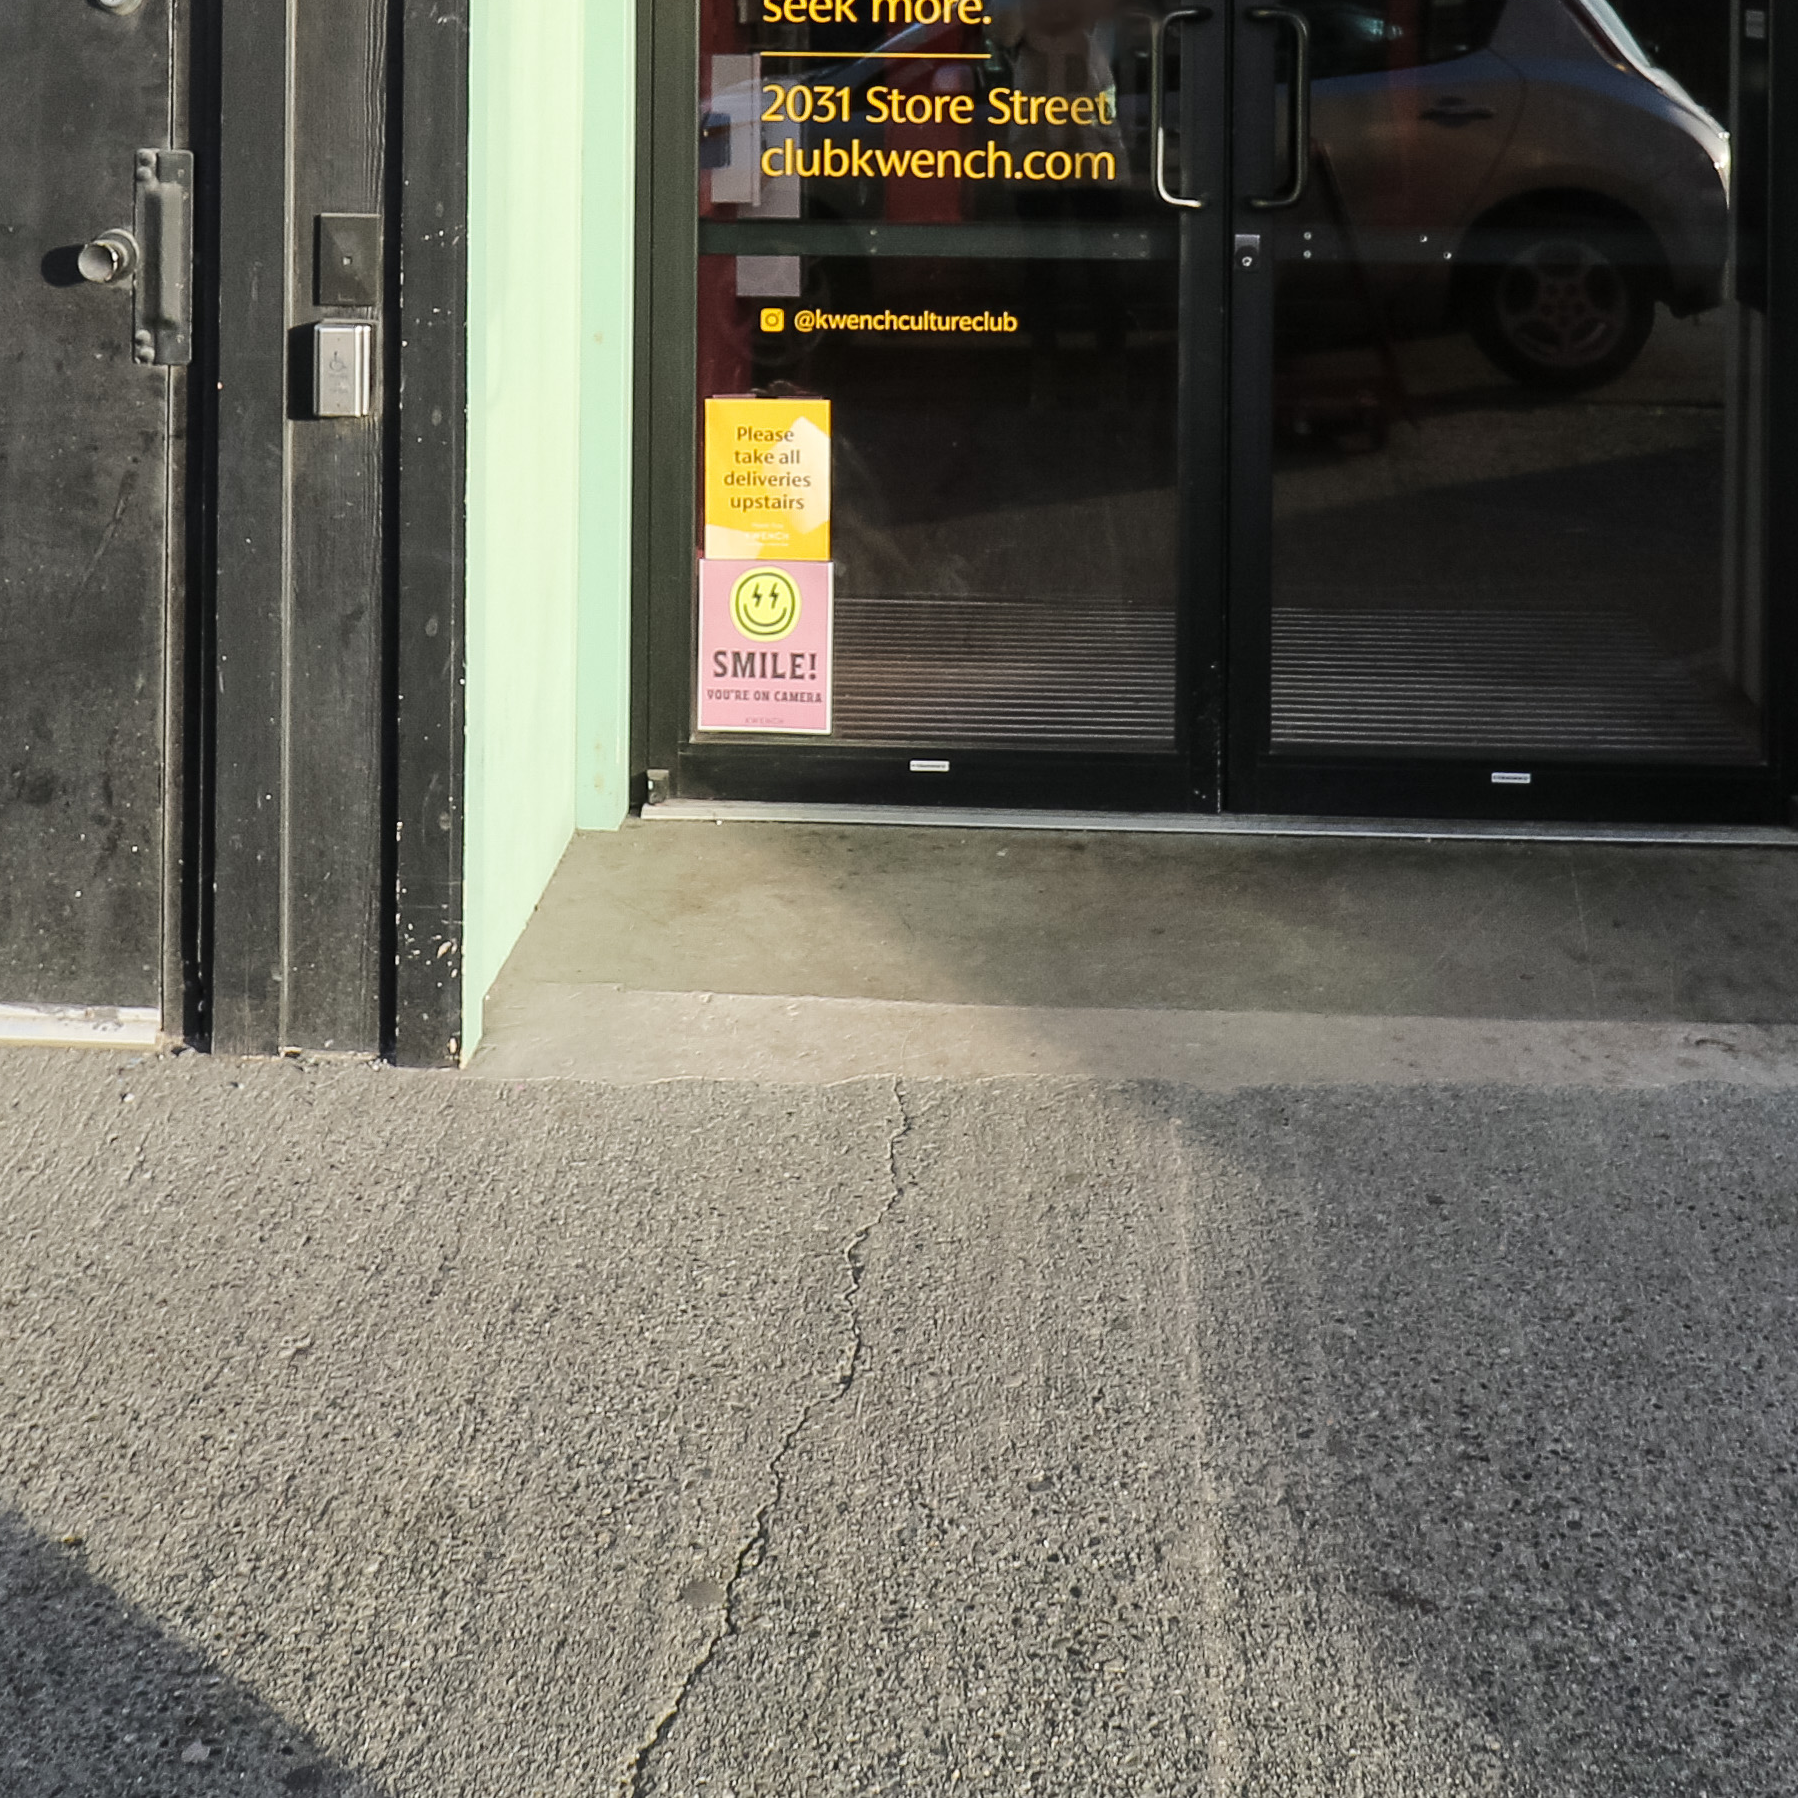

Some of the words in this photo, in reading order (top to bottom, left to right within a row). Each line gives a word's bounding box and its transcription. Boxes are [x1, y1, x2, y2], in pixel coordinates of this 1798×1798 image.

[760, 84, 852, 124] 2031
[865, 85, 975, 125] Store
[987, 87, 1114, 126] Street
[760, 137, 1116, 181] clubkwench.com
[794, 309, 1017, 333] @kwenchcultureclub
[736, 425, 795, 443] Please
[734, 448, 775, 465] take
[778, 449, 801, 465] all
[723, 470, 812, 488] deliveries
[729, 493, 806, 513] upstairs
[712, 649, 818, 681] SMILE!
[706, 689, 750, 701] YOU'RE
[752, 690, 771, 701] ON
[773, 691, 823, 703] CAMERA
